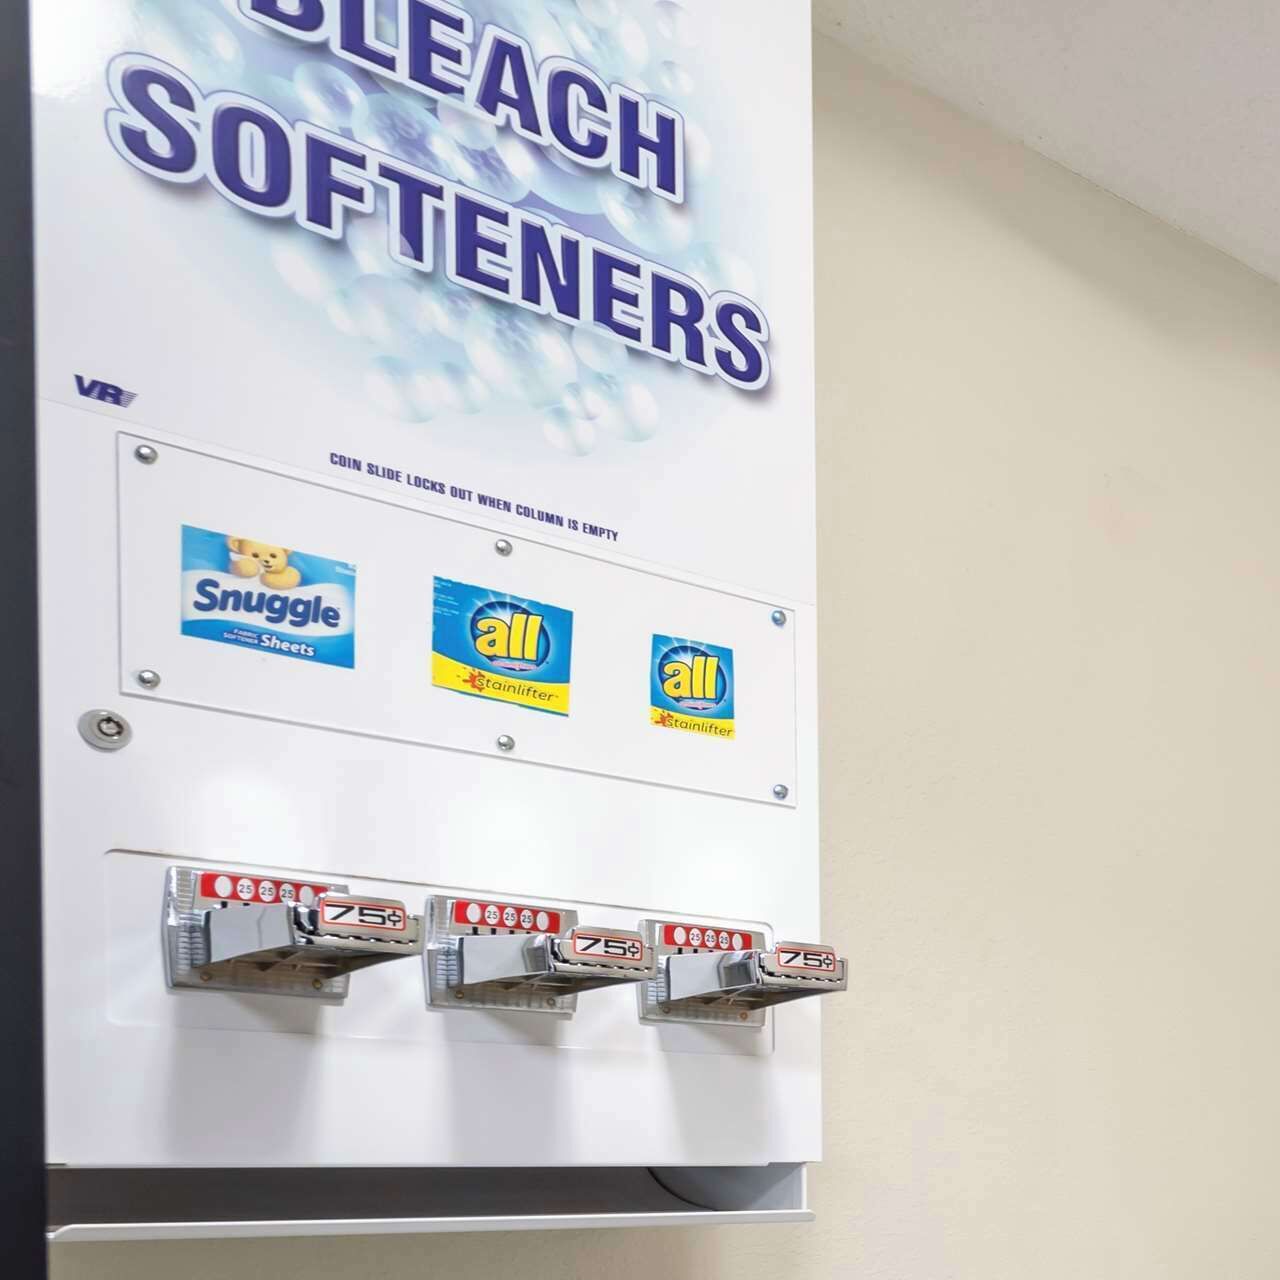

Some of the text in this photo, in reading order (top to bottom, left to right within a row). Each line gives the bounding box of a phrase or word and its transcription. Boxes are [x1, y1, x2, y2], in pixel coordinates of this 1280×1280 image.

[116, 60, 766, 387] SOFTENERS
[74, 374, 137, 408] VR
[330, 452, 619, 541] COIN SLIDE LOCKS OUT WHEN COLUMN IS EMPTY
[193, 578, 340, 628] Snuggle
[260, 633, 315, 656] Sheets
[474, 612, 544, 662] all
[477, 676, 554, 702] stainlifter
[662, 655, 720, 700] all
[667, 717, 733, 737] stainlifter
[238, 884, 294, 899] 25 25 25
[324, 903, 403, 927] 75¢
[486, 910, 533, 924] 25 25 25
[577, 936, 640, 957] 75¢
[690, 932, 729, 945] 25 25 25
[780, 950, 833, 969] 75¢
